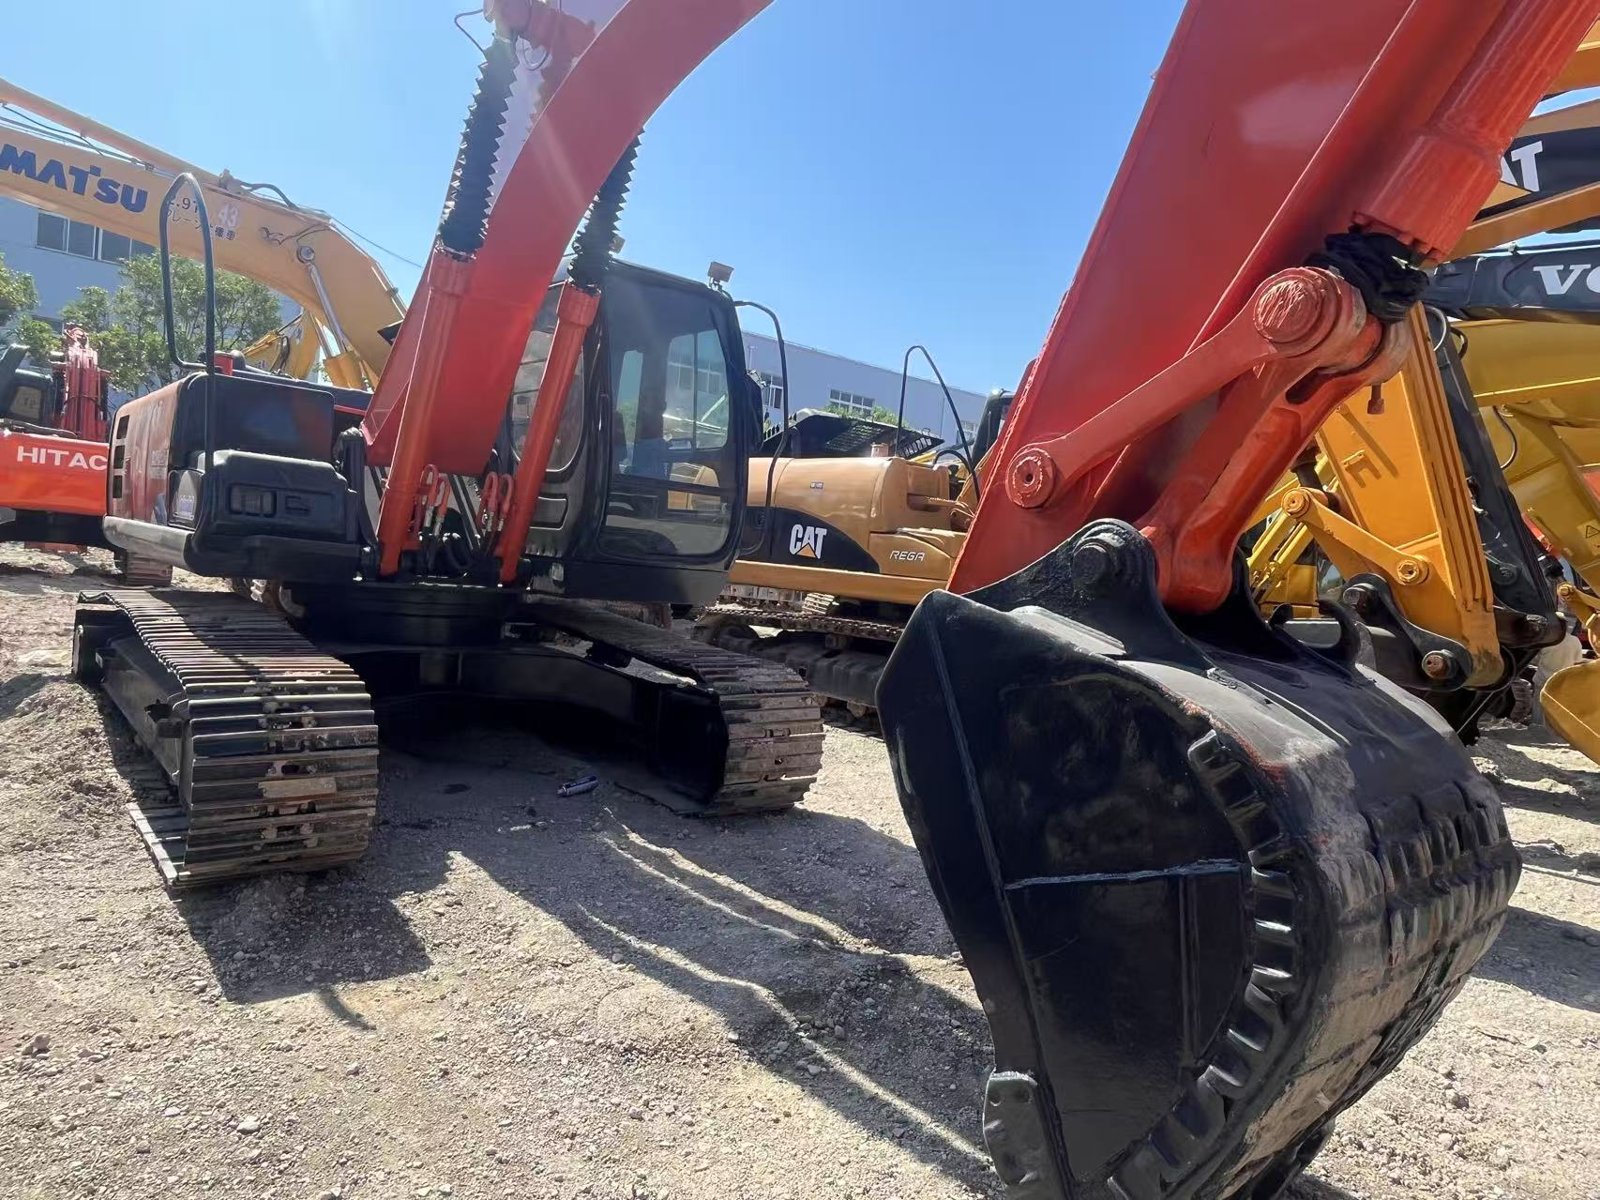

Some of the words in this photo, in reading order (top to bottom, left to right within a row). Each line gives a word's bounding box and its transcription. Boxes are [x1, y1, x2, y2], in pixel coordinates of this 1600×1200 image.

[0, 143, 149, 213] MATSU
[17, 445, 107, 471] HITAC
[789, 523, 828, 559] CAT
[889, 550, 925, 561] REGA
